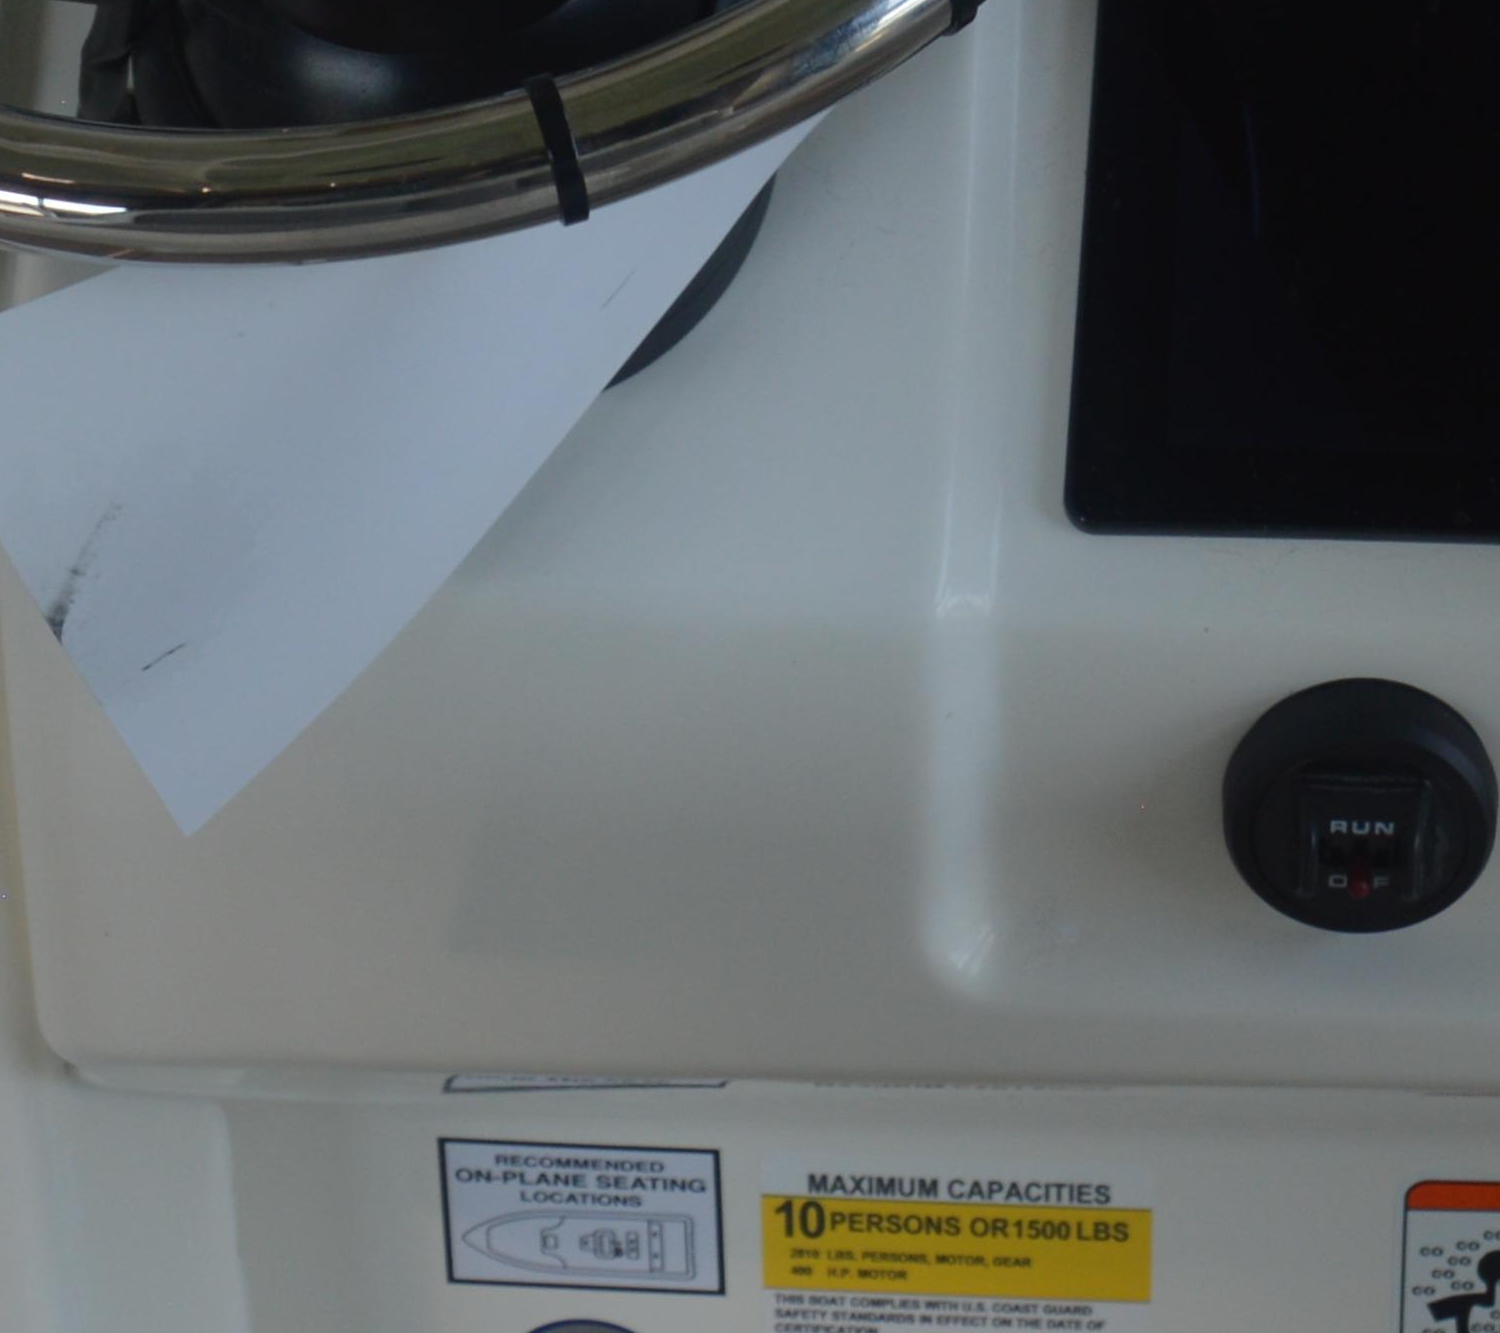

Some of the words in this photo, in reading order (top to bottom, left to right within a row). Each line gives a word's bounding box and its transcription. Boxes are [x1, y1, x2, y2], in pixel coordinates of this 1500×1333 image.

[1329, 819, 1396, 836] RUN
[1328, 874, 1389, 890] OF
[495, 1154, 664, 1173] RECOMMENDED
[455, 1167, 587, 1189] ON-PLANE
[596, 1174, 707, 1194] SEATING
[807, 1172, 938, 1201] MAXIMUM
[947, 1179, 1111, 1206] CAPACITIES
[520, 1190, 642, 1207] LOCATIONS
[774, 1199, 826, 1240] 10
[830, 1211, 961, 1238] PERSONS
[969, 1217, 1010, 1239] OR
[1013, 1219, 1071, 1242] 1500
[1077, 1221, 1129, 1243] LBS
[1420, 1246, 1443, 1257] CO
[1457, 1240, 1480, 1251] CO
[992, 1256, 1032, 1268] GEAR
[1448, 1255, 1471, 1266] CO
[856, 1269, 907, 1281] MOTOR
[1432, 1269, 1455, 1280] CO
[1412, 1285, 1435, 1296] CO
[1450, 1280, 1474, 1291] CO
[775, 1293, 804, 1306] THIS
[809, 1295, 846, 1307] BOAT
[850, 1297, 919, 1310] COMPLIES
[924, 1300, 959, 1311] WITH
[991, 1303, 1038, 1315] COAST
[1042, 1305, 1093, 1316] GUARD
[775, 1308, 827, 1321] SAFETY
[831, 1312, 914, 1325] STANDARDS
[918, 1314, 932, 1325] IN
[935, 1315, 987, 1328] EFFECT
[992, 1317, 1012, 1328] ON
[1017, 1319, 1042, 1330] THE
[1046, 1320, 1083, 1331] DATE
[1086, 1321, 1107, 1332] OF
[1472, 1323, 1495, 1333] CO
